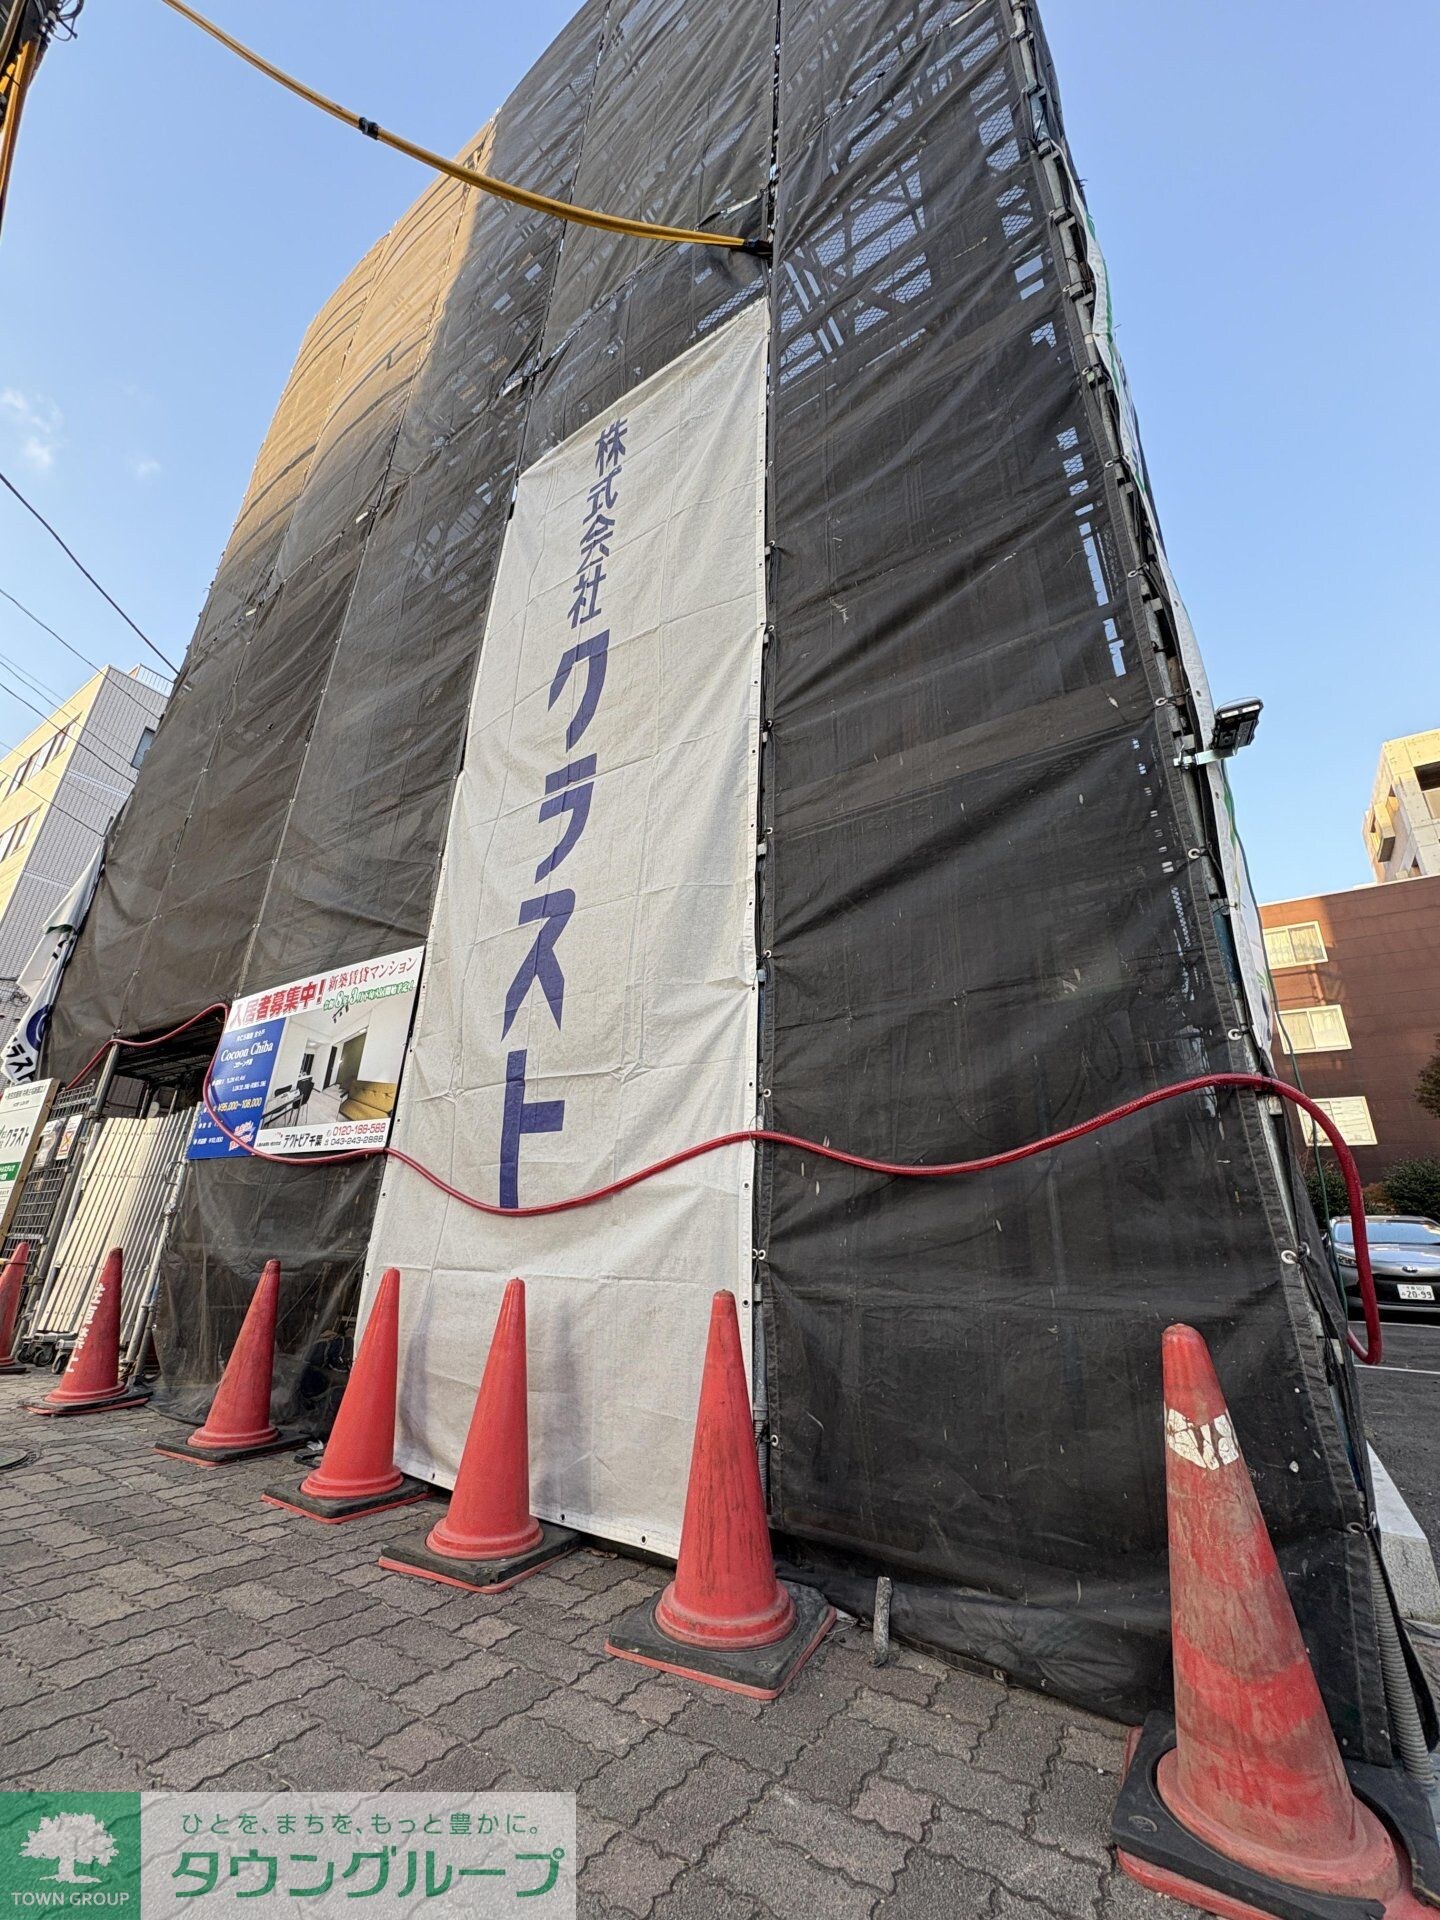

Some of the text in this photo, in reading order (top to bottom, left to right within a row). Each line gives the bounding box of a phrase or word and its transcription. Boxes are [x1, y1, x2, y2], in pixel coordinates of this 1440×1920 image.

[328, 957, 417, 991] 新築賃貸マンション
[221, 1040, 273, 1062] Cocoon Chiba
